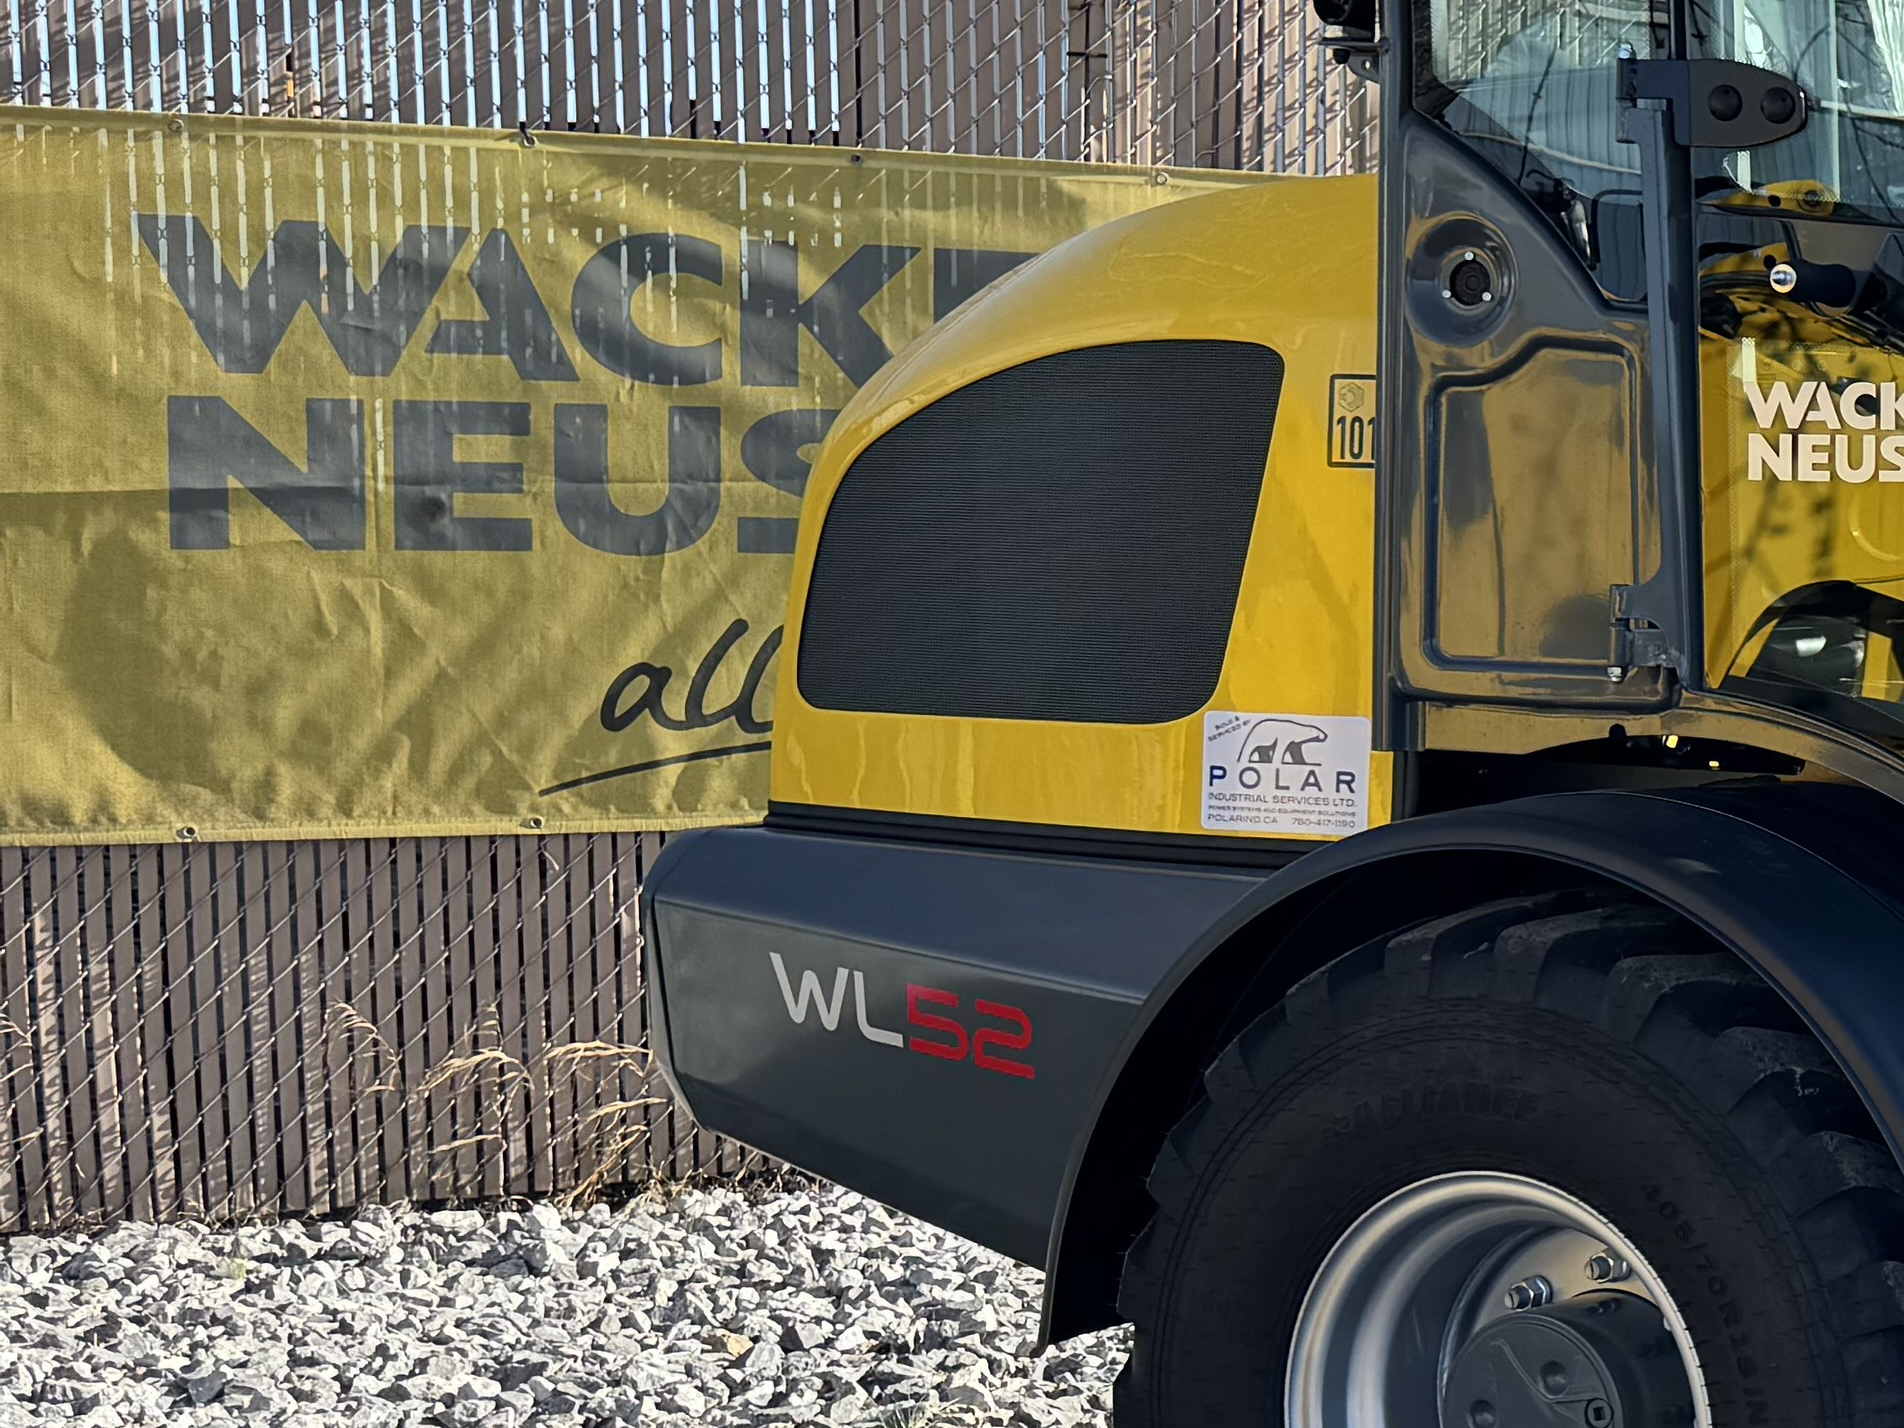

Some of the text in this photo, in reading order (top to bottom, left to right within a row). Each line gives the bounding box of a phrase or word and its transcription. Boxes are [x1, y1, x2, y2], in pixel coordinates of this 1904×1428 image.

[1209, 765, 1356, 794] POLAR
[1208, 792, 1268, 804] INDUSTRIAL
[1272, 795, 1329, 806] SERVICES
[770, 951, 1036, 1080] WL52
